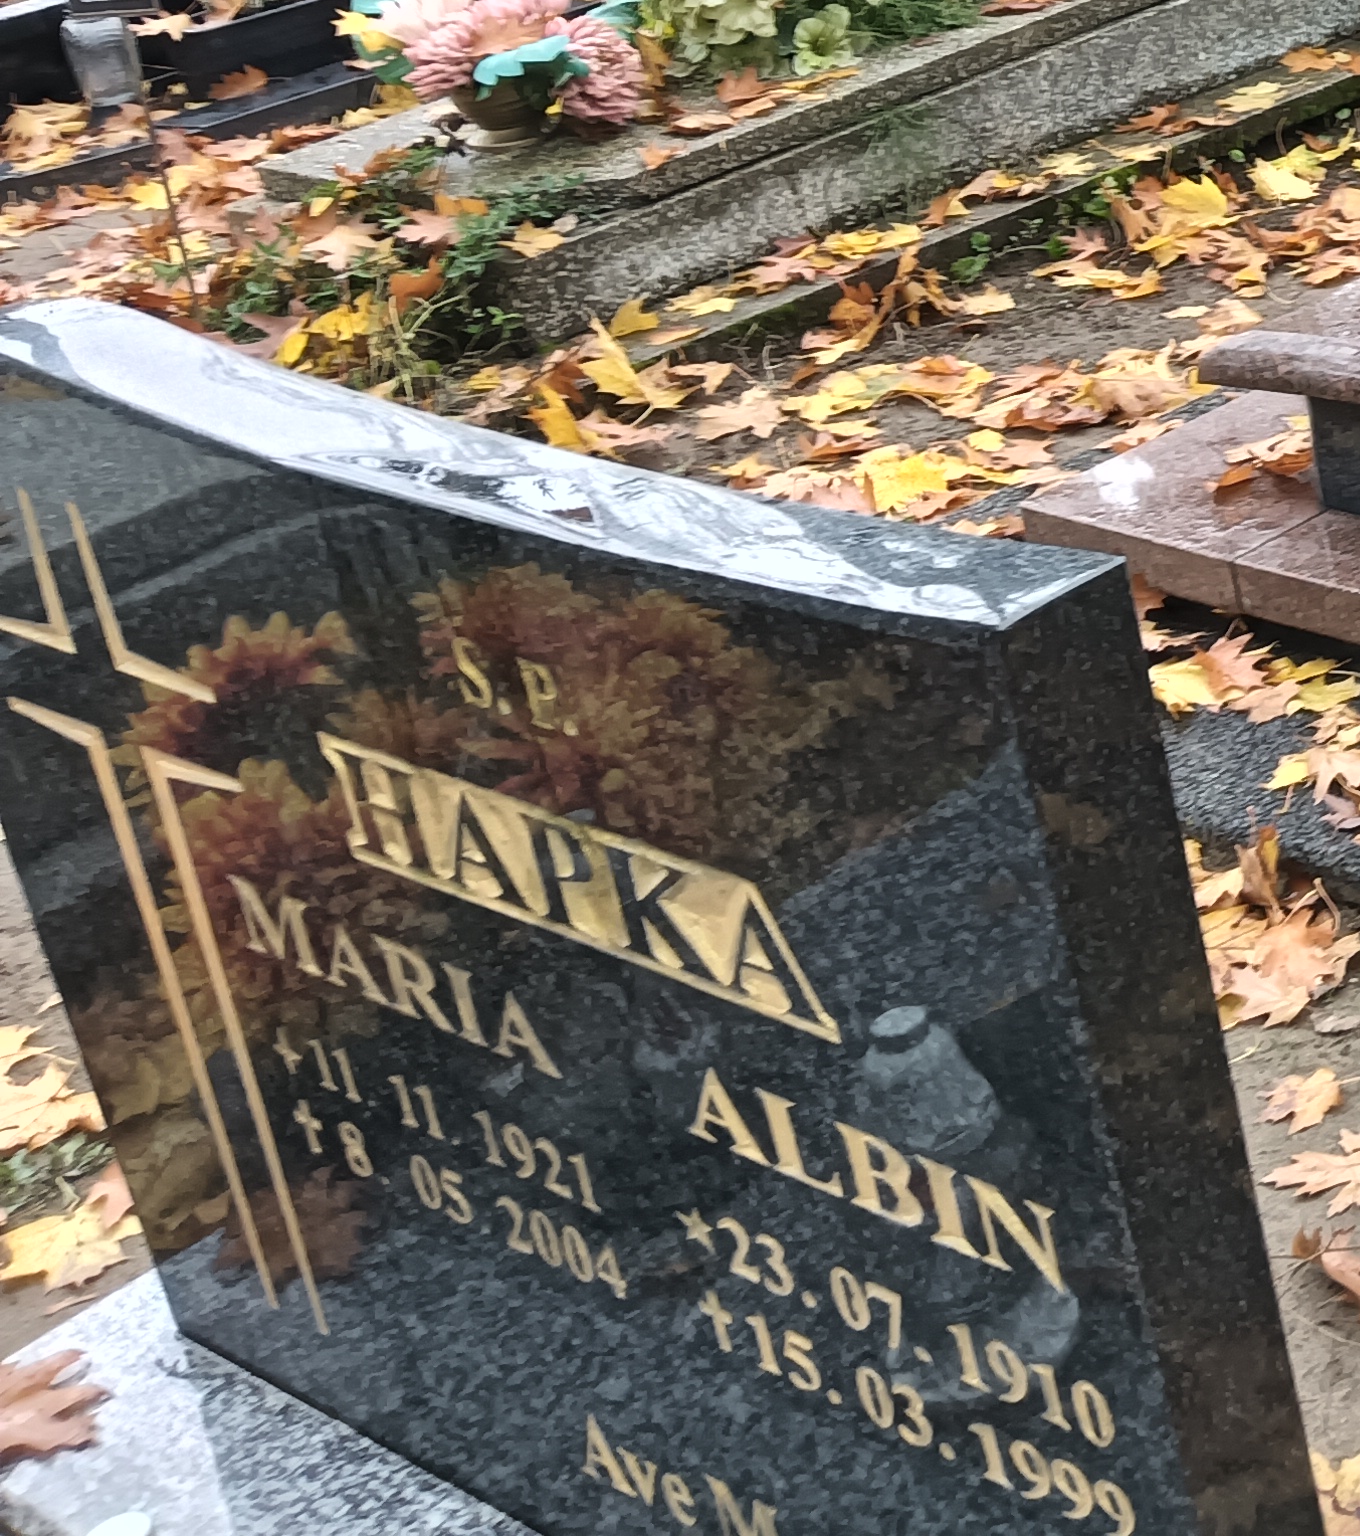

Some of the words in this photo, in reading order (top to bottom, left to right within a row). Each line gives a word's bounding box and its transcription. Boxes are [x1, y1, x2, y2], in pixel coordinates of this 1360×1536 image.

[226, 873, 563, 1079] MARIA
[317, 730, 842, 1044] HAPKA
[686, 1066, 1066, 1296] ALBIN
[581, 1413, 697, 1527] Ave
